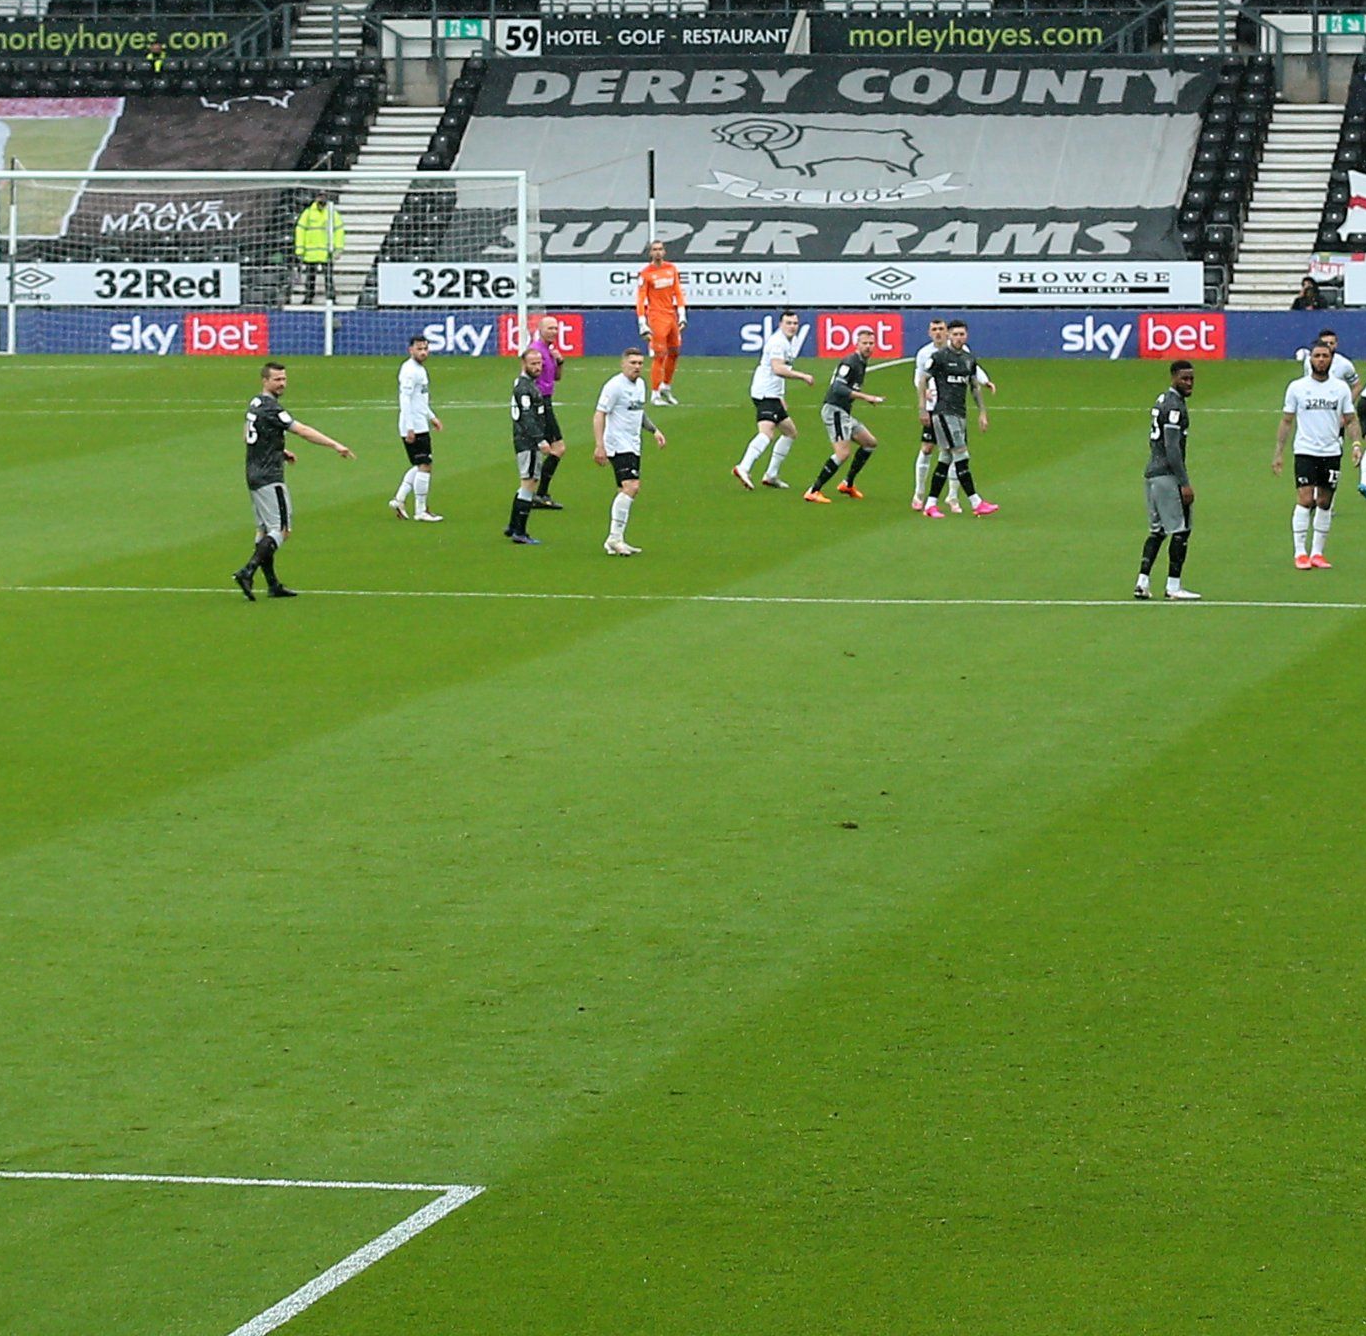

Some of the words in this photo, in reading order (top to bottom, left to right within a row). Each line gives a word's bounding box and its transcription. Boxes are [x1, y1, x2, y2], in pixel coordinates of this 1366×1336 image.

[504, 25, 540, 52] 59
[546, 30, 600, 46] HOTEL
[617, 29, 666, 46] GOLF
[682, 28, 789, 45] RESTAURANT
[849, 21, 1103, 53] morleyhayes.com
[506, 67, 813, 105] DERBY
[838, 67, 1202, 105] COUNTY
[134, 200, 224, 214] DAVE
[101, 211, 243, 234] MACKAY
[482, 219, 819, 256] SUPER
[842, 219, 1138, 256] RAMS
[94, 268, 222, 299] 32Red
[610, 271, 763, 284] CHETOWN
[998, 271, 1171, 283] SHOWCASE
[870, 291, 912, 302] umbro
[1037, 286, 1084, 294] CINEMA
[1088, 286, 1104, 294] DE
[1107, 286, 1131, 294] LUX
[110, 316, 179, 357] sky
[193, 318, 259, 351] bet
[423, 316, 494, 357] sky
[507, 318, 573, 351] bt
[1062, 315, 1132, 360] sky
[1147, 317, 1216, 351] bet
[1305, 398, 1339, 410] 32Red
